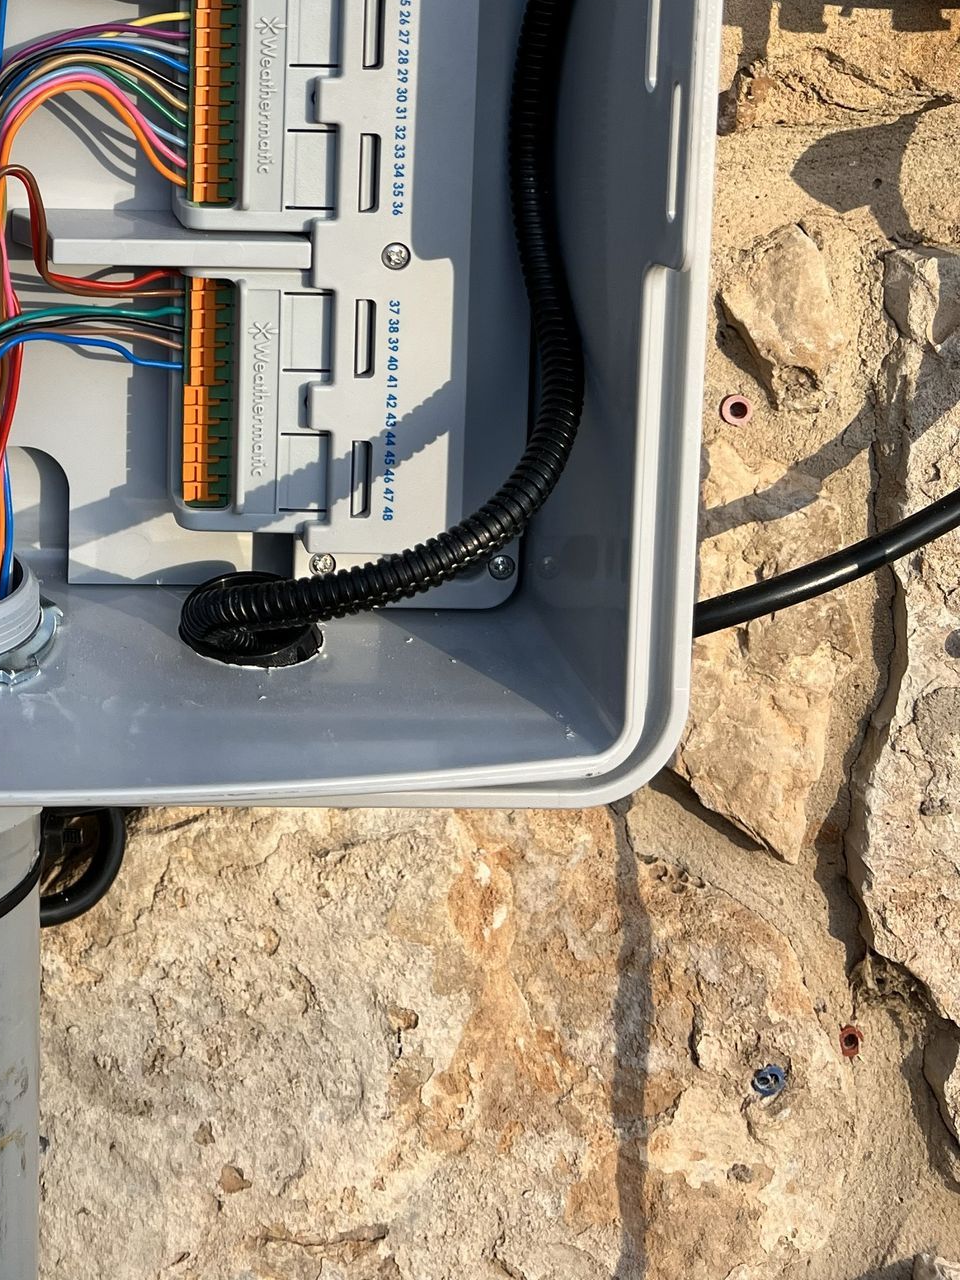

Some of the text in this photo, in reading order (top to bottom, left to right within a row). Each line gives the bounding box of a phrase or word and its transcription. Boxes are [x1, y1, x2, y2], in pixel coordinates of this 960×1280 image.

[399, 10, 411, 26] 26
[398, 29, 410, 45] 27
[397, 49, 410, 64] 28
[397, 68, 409, 84] 29
[396, 87, 408, 103] 30
[257, 35, 278, 174] Weathermatic
[395, 106, 407, 120] 31
[394, 125, 407, 140] 32
[394, 144, 406, 159] 33
[393, 163, 405, 178] 34
[392, 182, 404, 197] 35
[391, 201, 404, 216] 36
[251, 336, 271, 478] Weathermatic
[382, 300, 401, 521] 37 38 39 40 41 42 43 44 45 46 47 48
